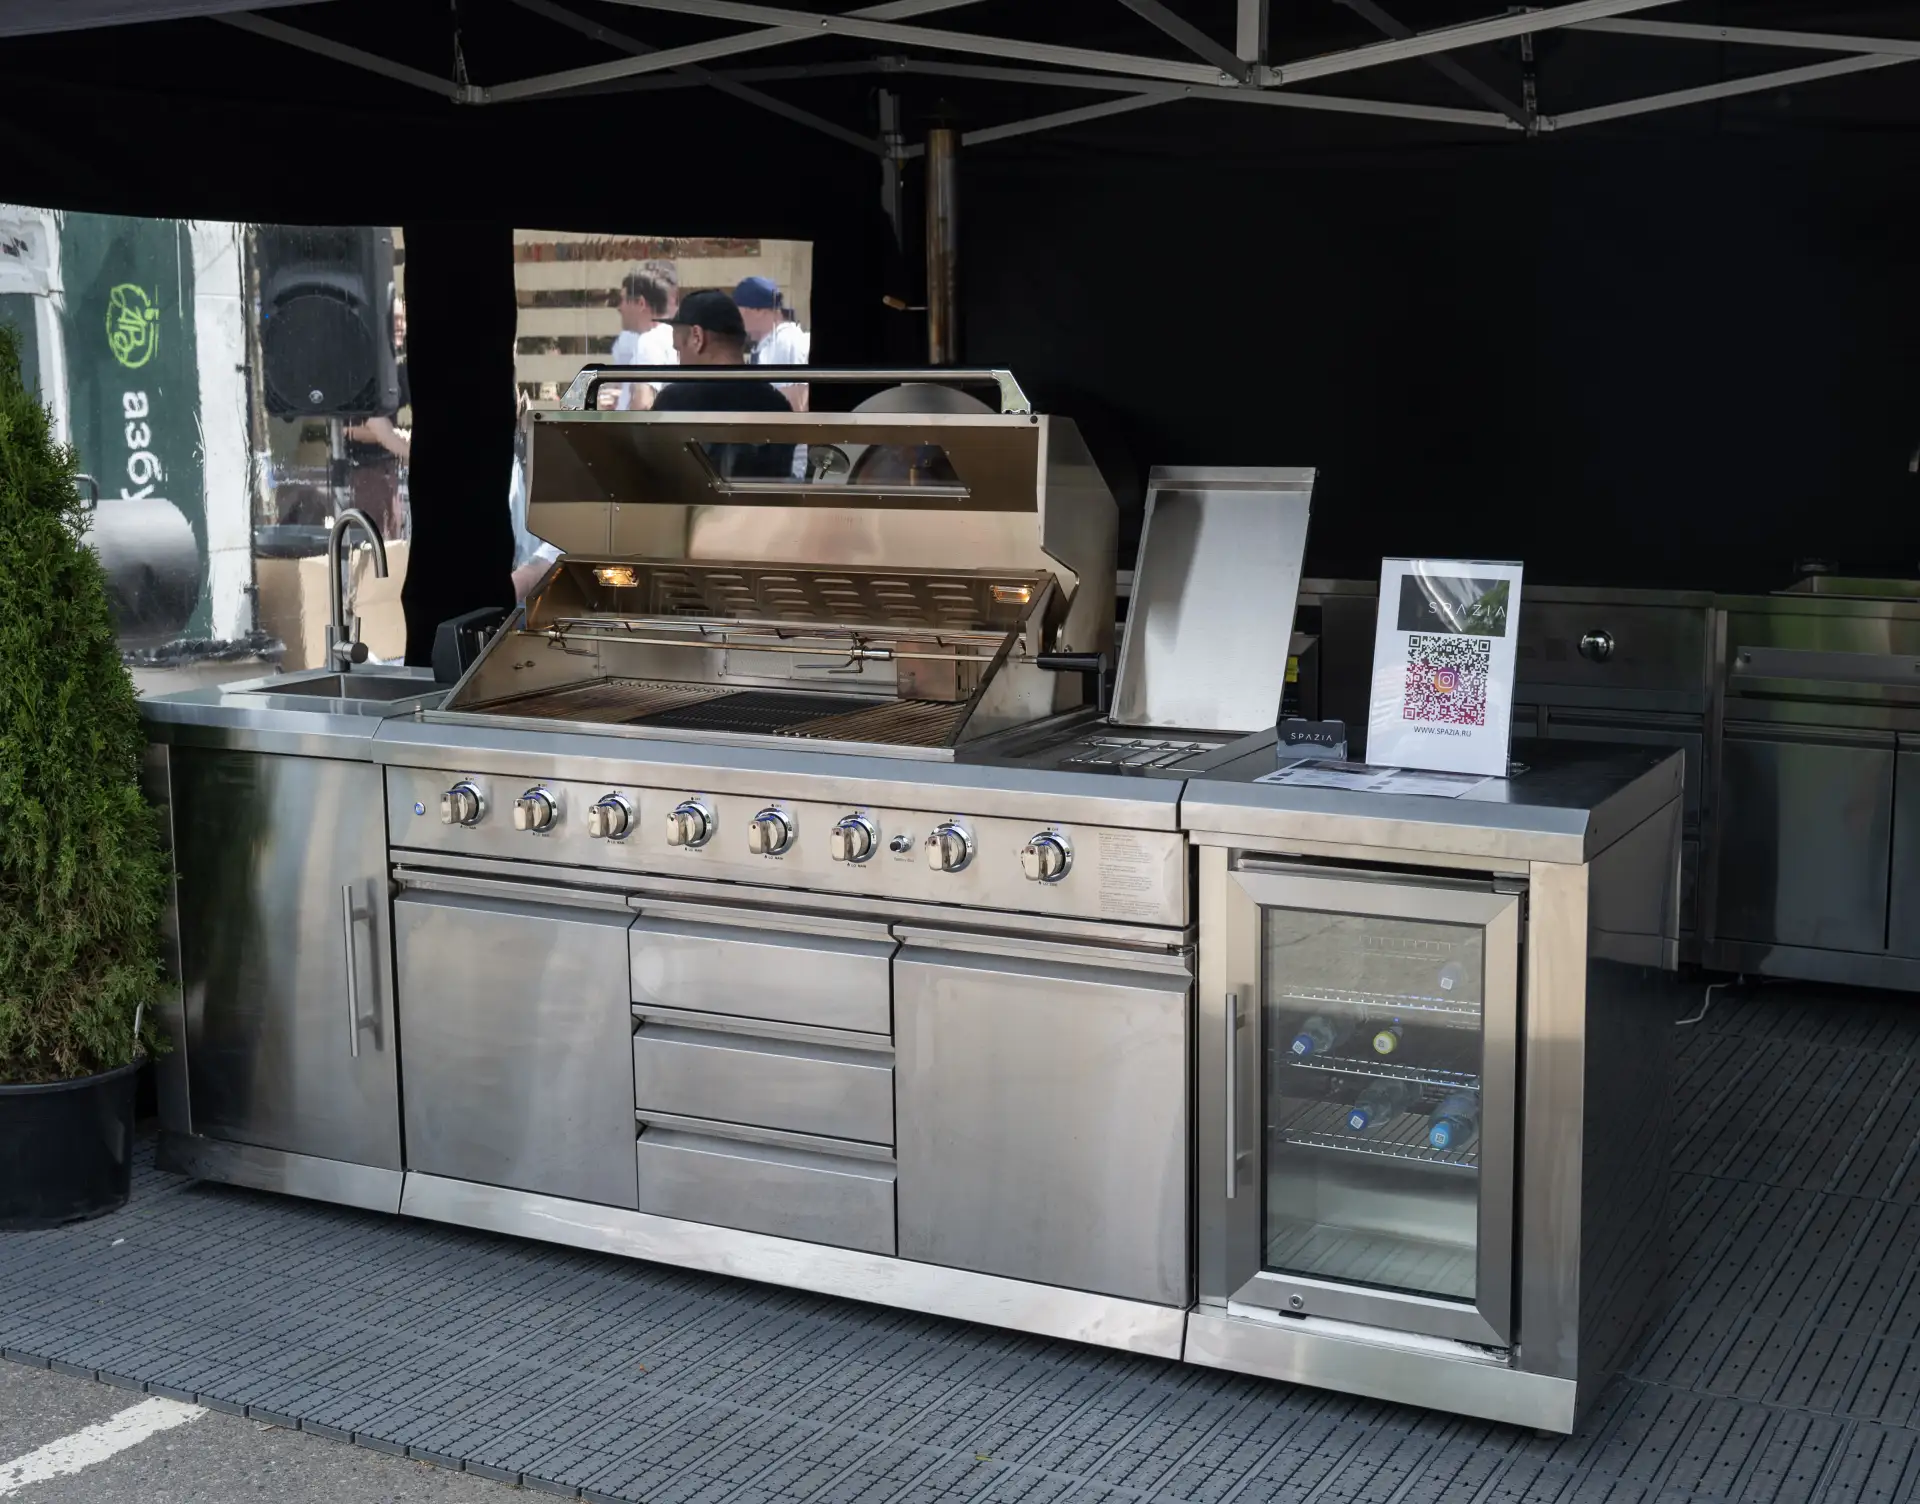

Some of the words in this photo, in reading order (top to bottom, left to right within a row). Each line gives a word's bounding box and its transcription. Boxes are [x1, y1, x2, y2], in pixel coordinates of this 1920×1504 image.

[1428, 601, 1506, 617] SPAZIA
[1290, 732, 1333, 741] SPAZIA
[1413, 725, 1472, 737] WWW.SPAZIA.RU
